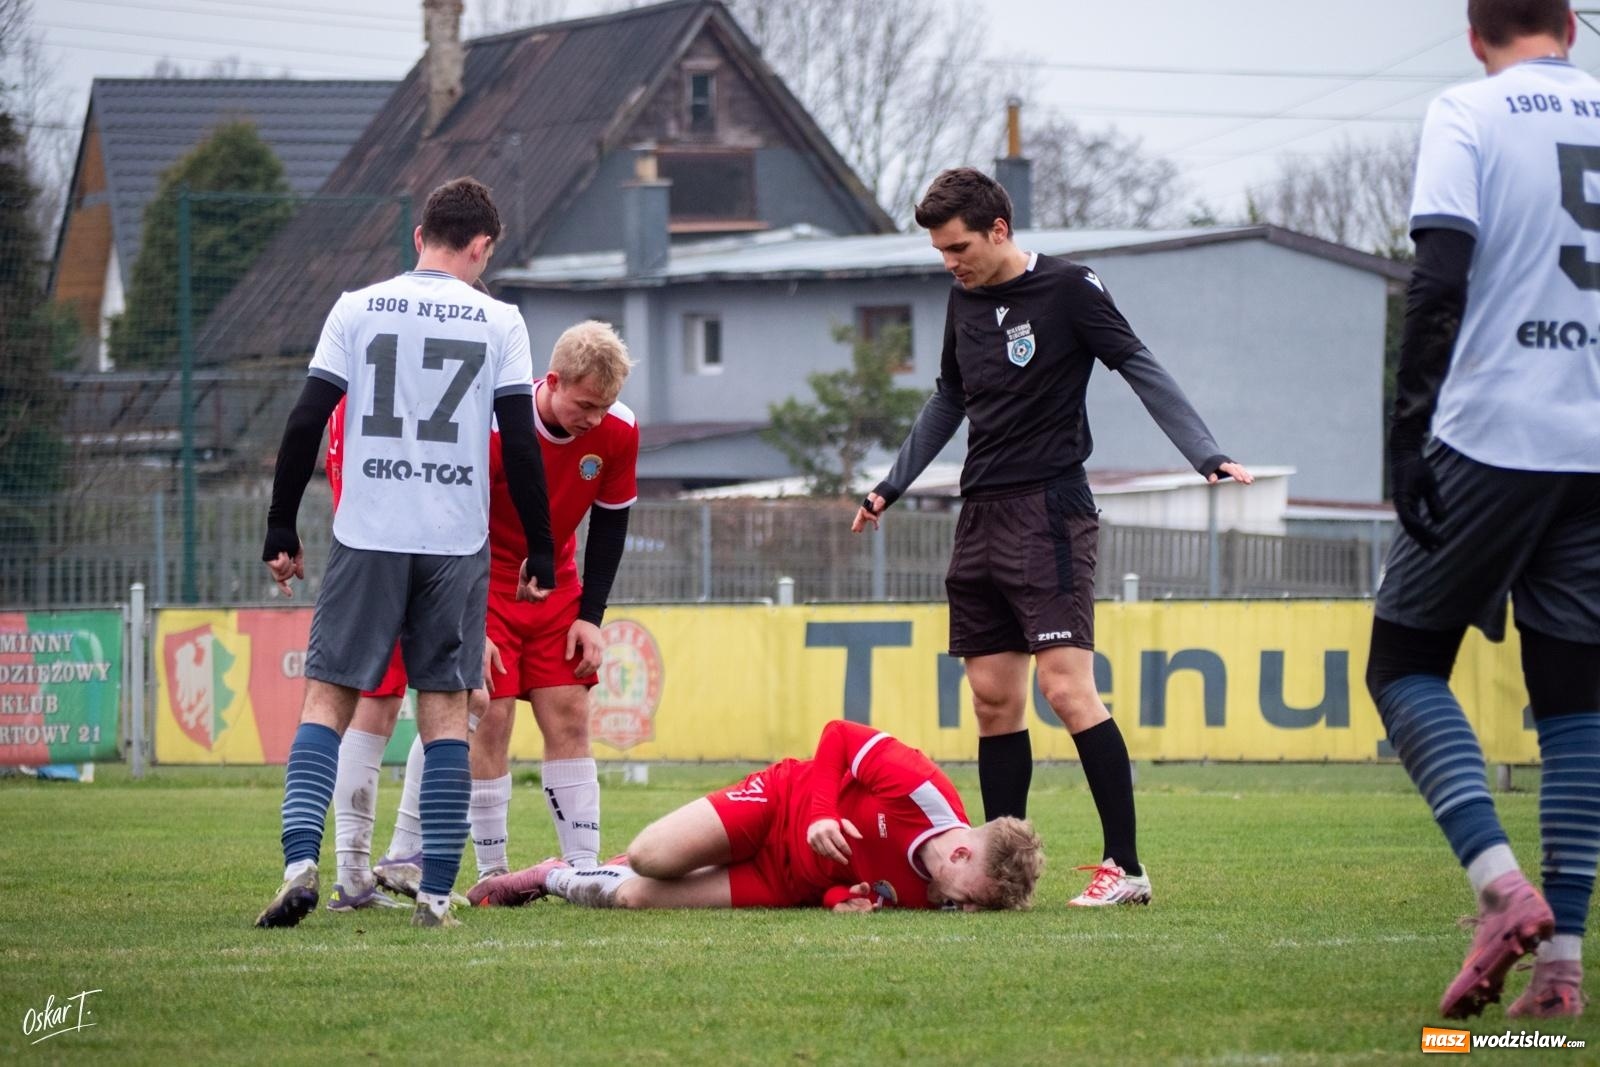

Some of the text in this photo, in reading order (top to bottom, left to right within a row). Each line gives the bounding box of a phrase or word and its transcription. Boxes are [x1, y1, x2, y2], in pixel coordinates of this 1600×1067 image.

[1506, 94, 1563, 114] 1908
[1556, 142, 1600, 291] 5
[366, 297, 488, 323] 1908 NĘDZA
[1516, 320, 1600, 351] EKO-
[361, 333, 487, 443] 17
[362, 457, 474, 486] EKO-TOX
[1, 693, 58, 714] KLUB
[78, 723, 100, 743] 21
